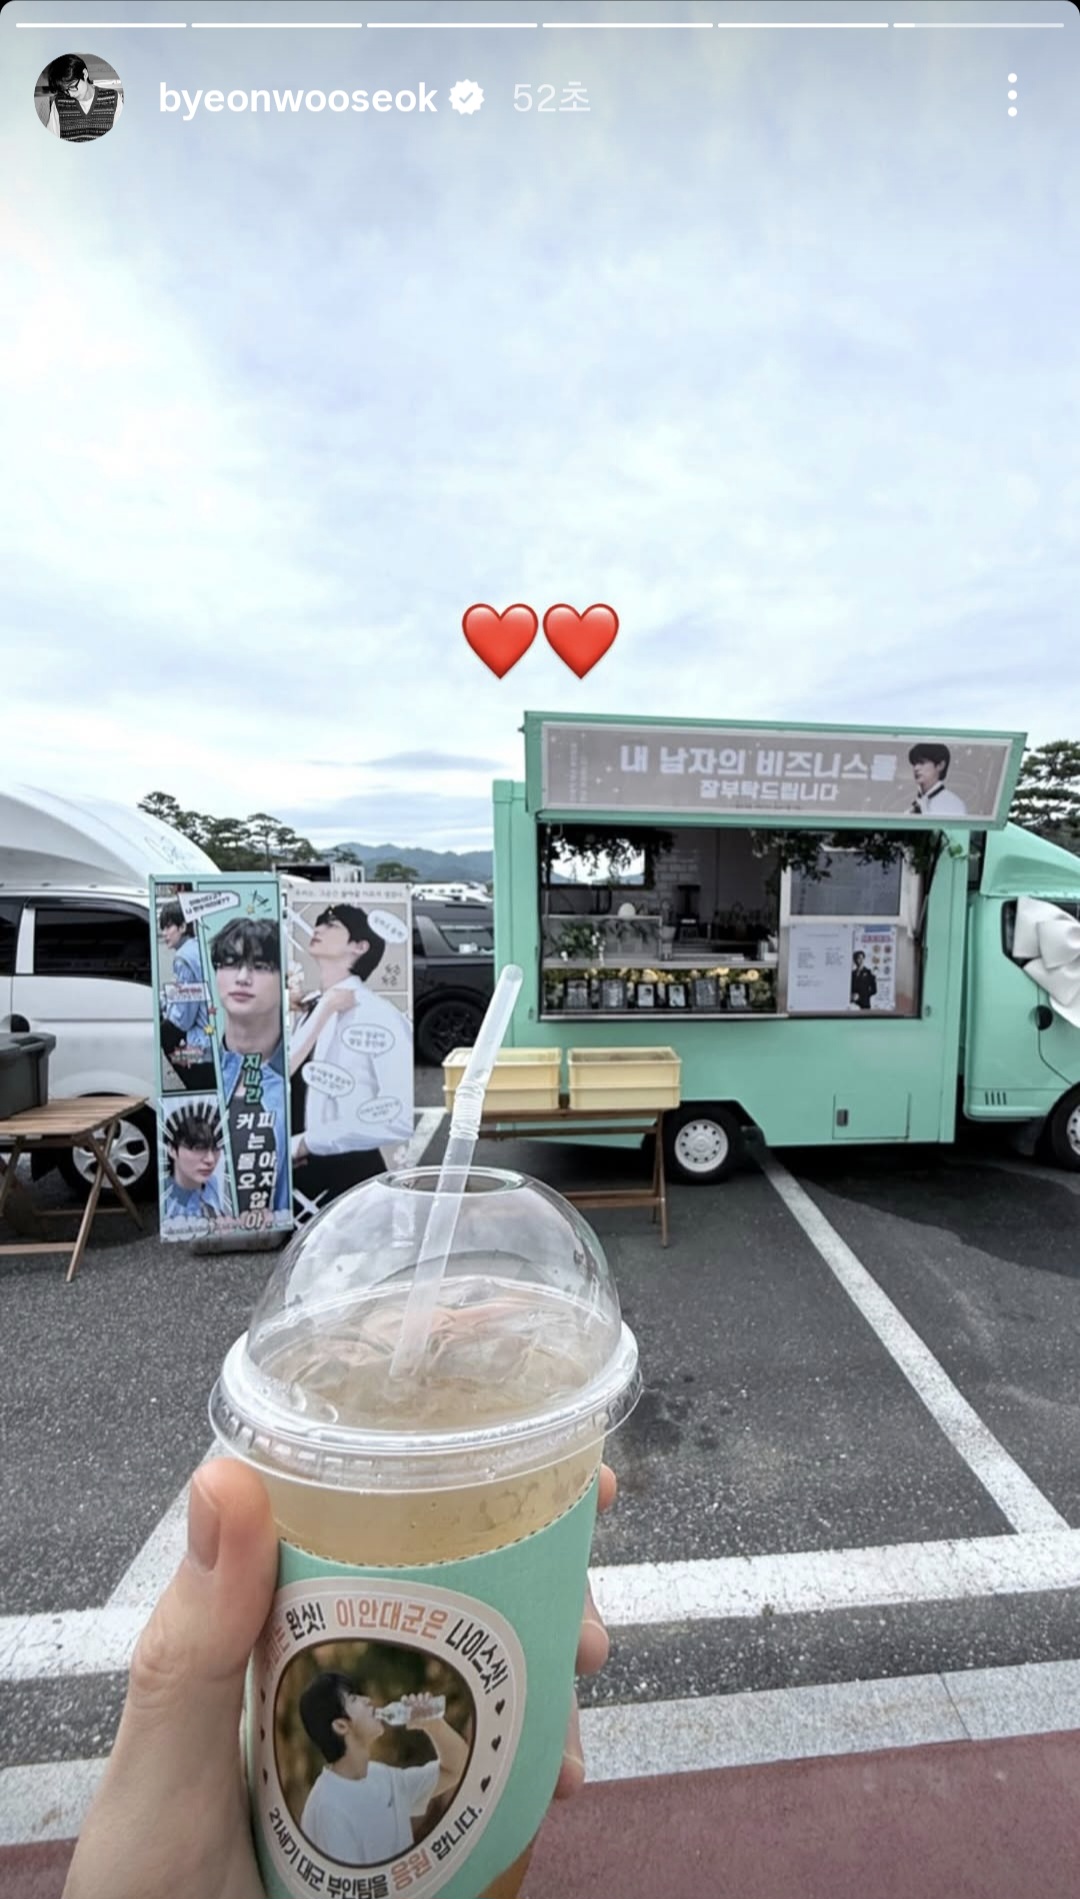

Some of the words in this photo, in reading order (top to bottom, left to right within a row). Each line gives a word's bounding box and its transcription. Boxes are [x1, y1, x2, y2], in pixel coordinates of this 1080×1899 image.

[620, 744, 648, 773] 내
[659, 746, 746, 775] 남자의
[756, 749, 897, 782] 비즈니스를
[700, 778, 839, 801] 잘부탁드립니다
[286, 1602, 326, 1641] 원샷!
[336, 1598, 449, 1640] 이안대군은
[445, 1618, 508, 1695] 나이스샷!
[269, 1806, 301, 1865] 21세기
[296, 1855, 326, 1892] 대군
[391, 1847, 433, 1891] 응원
[431, 1805, 483, 1861] 합니다.
